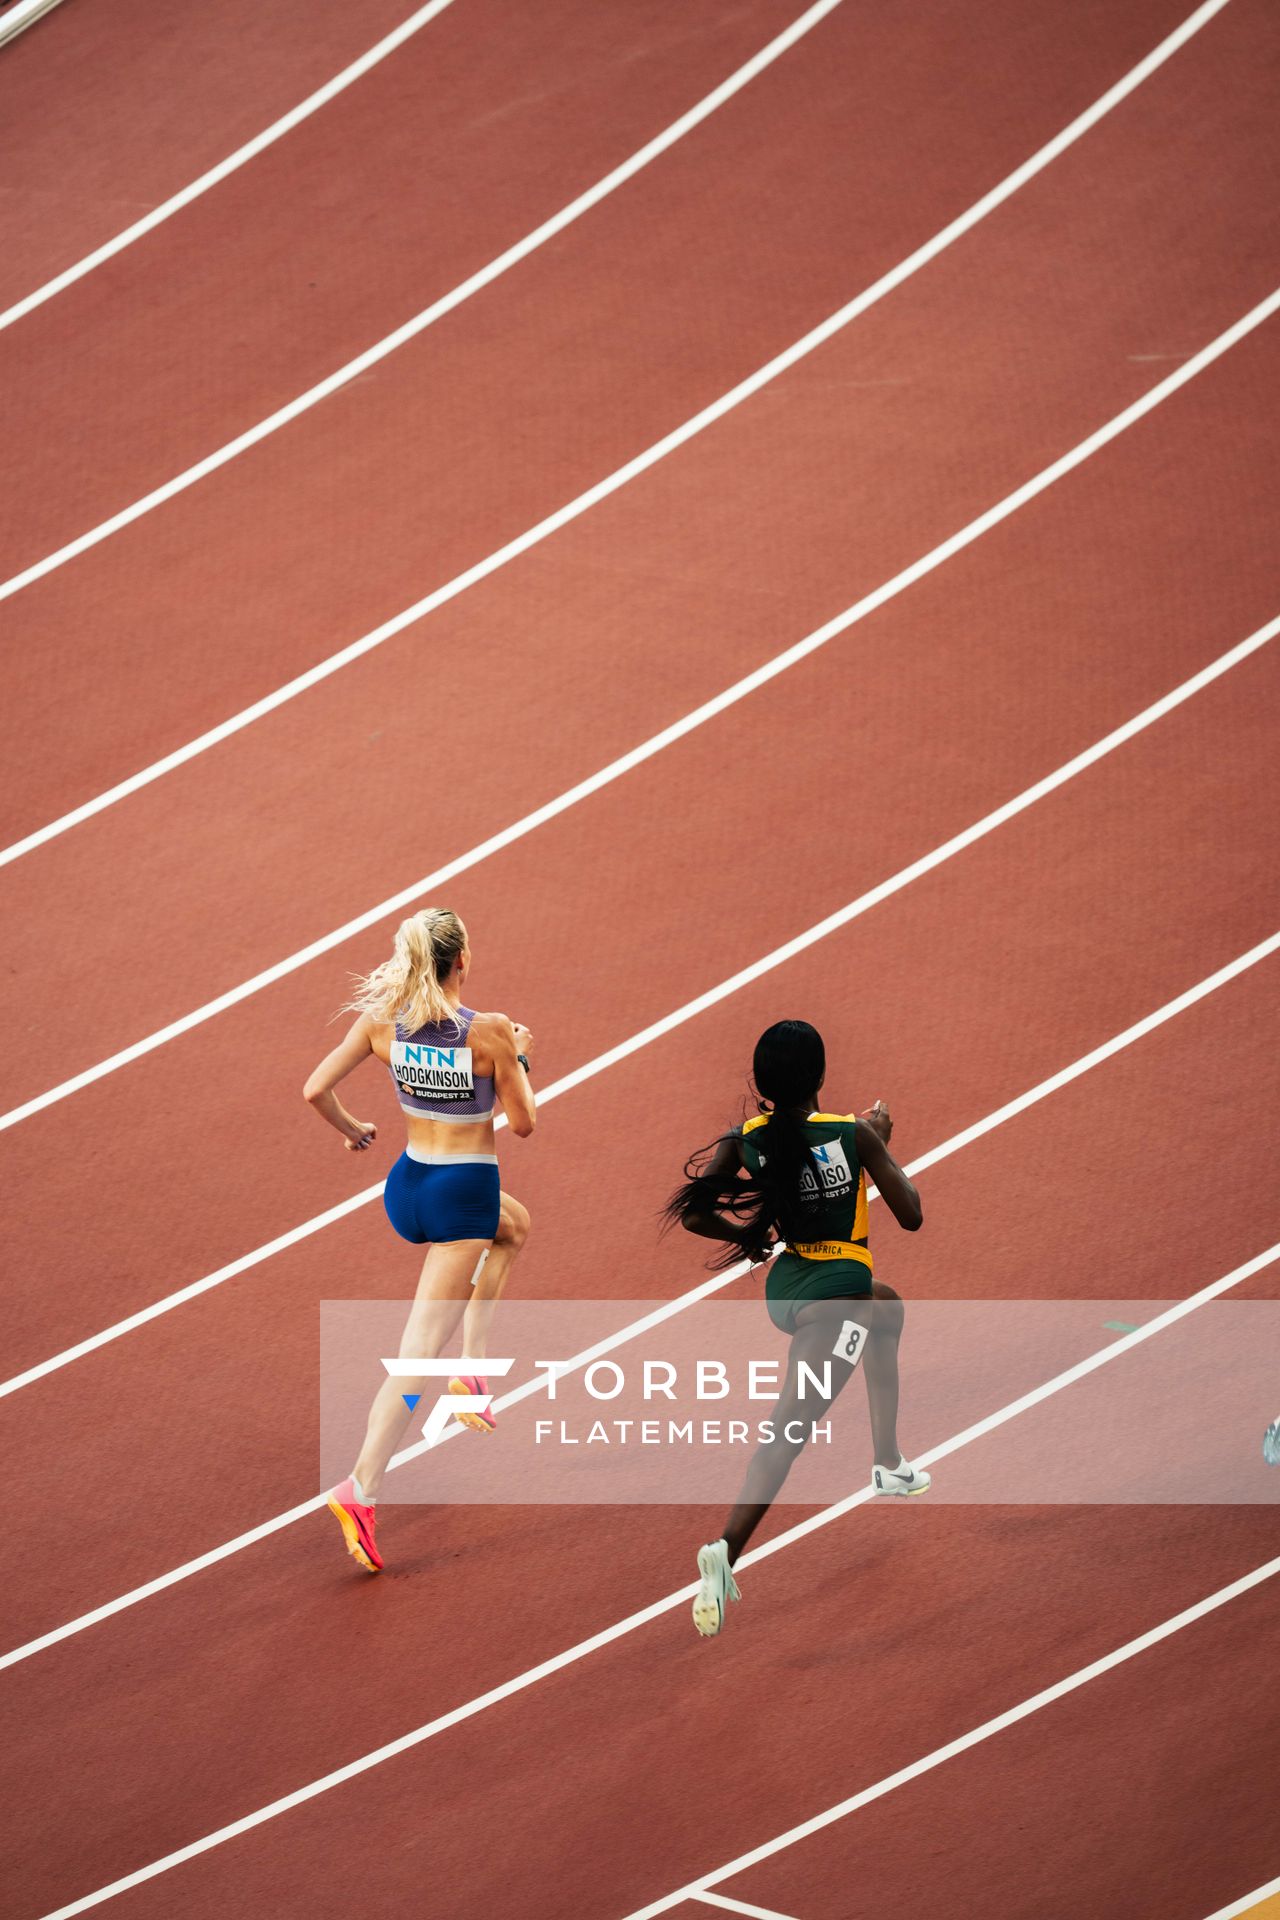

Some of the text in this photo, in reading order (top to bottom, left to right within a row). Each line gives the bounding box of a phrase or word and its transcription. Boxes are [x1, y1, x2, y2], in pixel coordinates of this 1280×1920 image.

[405, 1045, 455, 1068] NTN
[394, 1064, 469, 1088] HODGKINSON
[416, 1090, 458, 1099] BUDAPEST
[814, 1244, 842, 1255] AFRICA
[845, 1329, 860, 1357] 8
